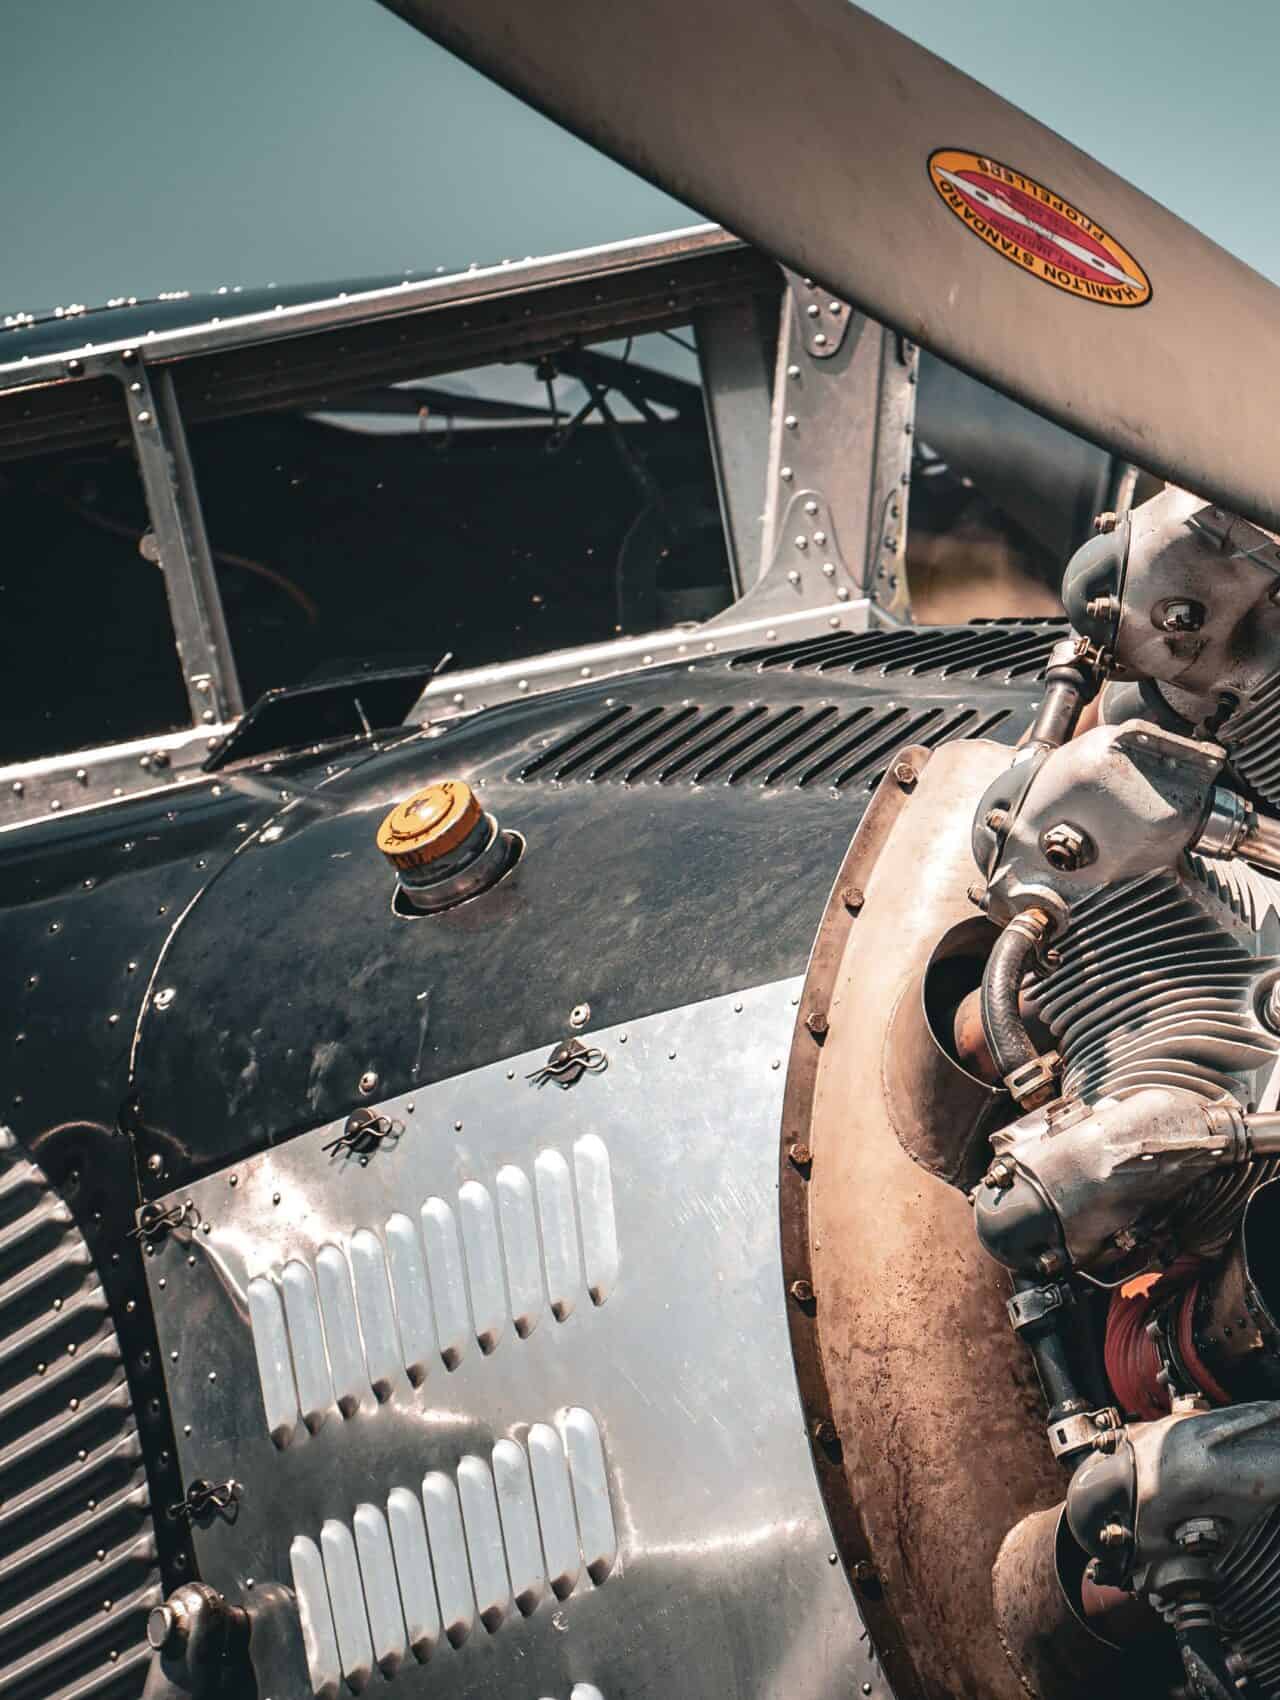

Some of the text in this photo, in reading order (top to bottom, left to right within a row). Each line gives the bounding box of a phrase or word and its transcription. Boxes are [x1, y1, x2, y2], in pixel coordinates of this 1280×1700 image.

[938, 180, 1035, 268] STANDARD
[976, 158, 1106, 242] PROPELLERS
[1043, 263, 1137, 301] HAMILTON
